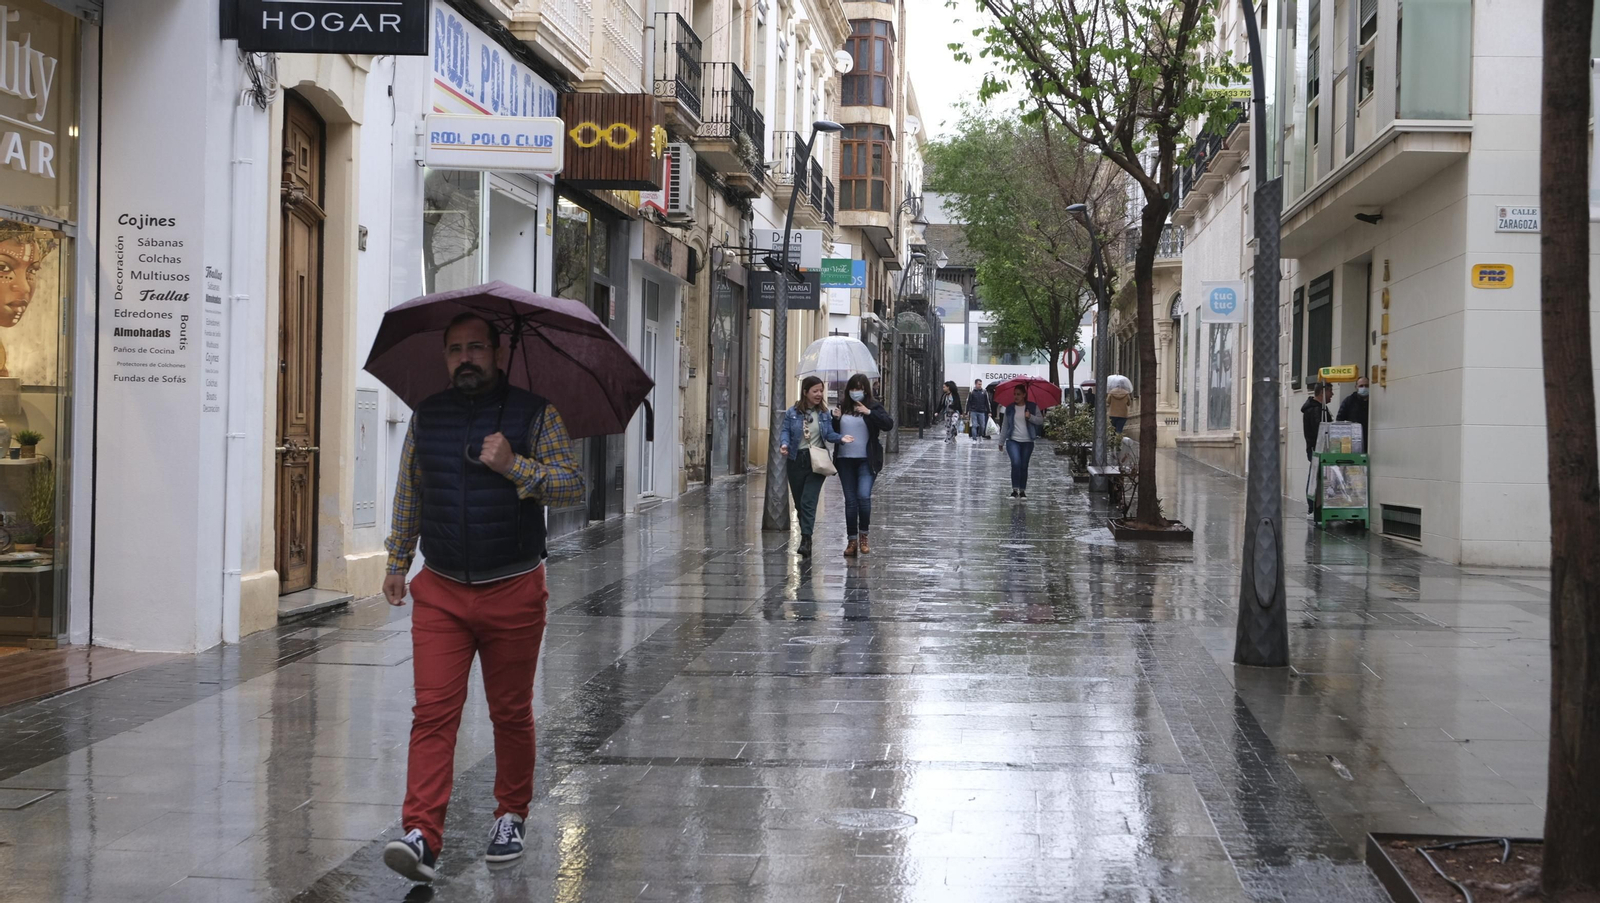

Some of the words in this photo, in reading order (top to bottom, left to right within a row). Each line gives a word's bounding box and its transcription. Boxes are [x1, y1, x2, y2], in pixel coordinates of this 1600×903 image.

[262, 11, 401, 33] HOGAR
[1239, 90, 1252, 98] 713
[431, 131, 466, 145] ROOL
[471, 133, 510, 146] POLO
[515, 134, 553, 147] CLUB
[118, 213, 176, 230] Cojines
[1499, 219, 1538, 230] ZARAGOZA
[137, 237, 184, 248] Sábanas
[138, 253, 182, 264] Colchas
[114, 235, 124, 300] Decoración
[130, 270, 190, 282] Multiusos
[763, 284, 809, 292] MANARIA
[139, 289, 190, 302] Toallas
[1213, 292, 1233, 300] tuc
[1213, 301, 1233, 310] tuc
[114, 308, 173, 319] Edredones
[113, 327, 171, 338] Almohadas
[179, 314, 189, 351] Boutis
[113, 346, 136, 354] Paños
[149, 347, 175, 355] Cocina
[113, 374, 146, 383] Fundas
[147, 375, 160, 383] de
[161, 375, 187, 384] Sofás
